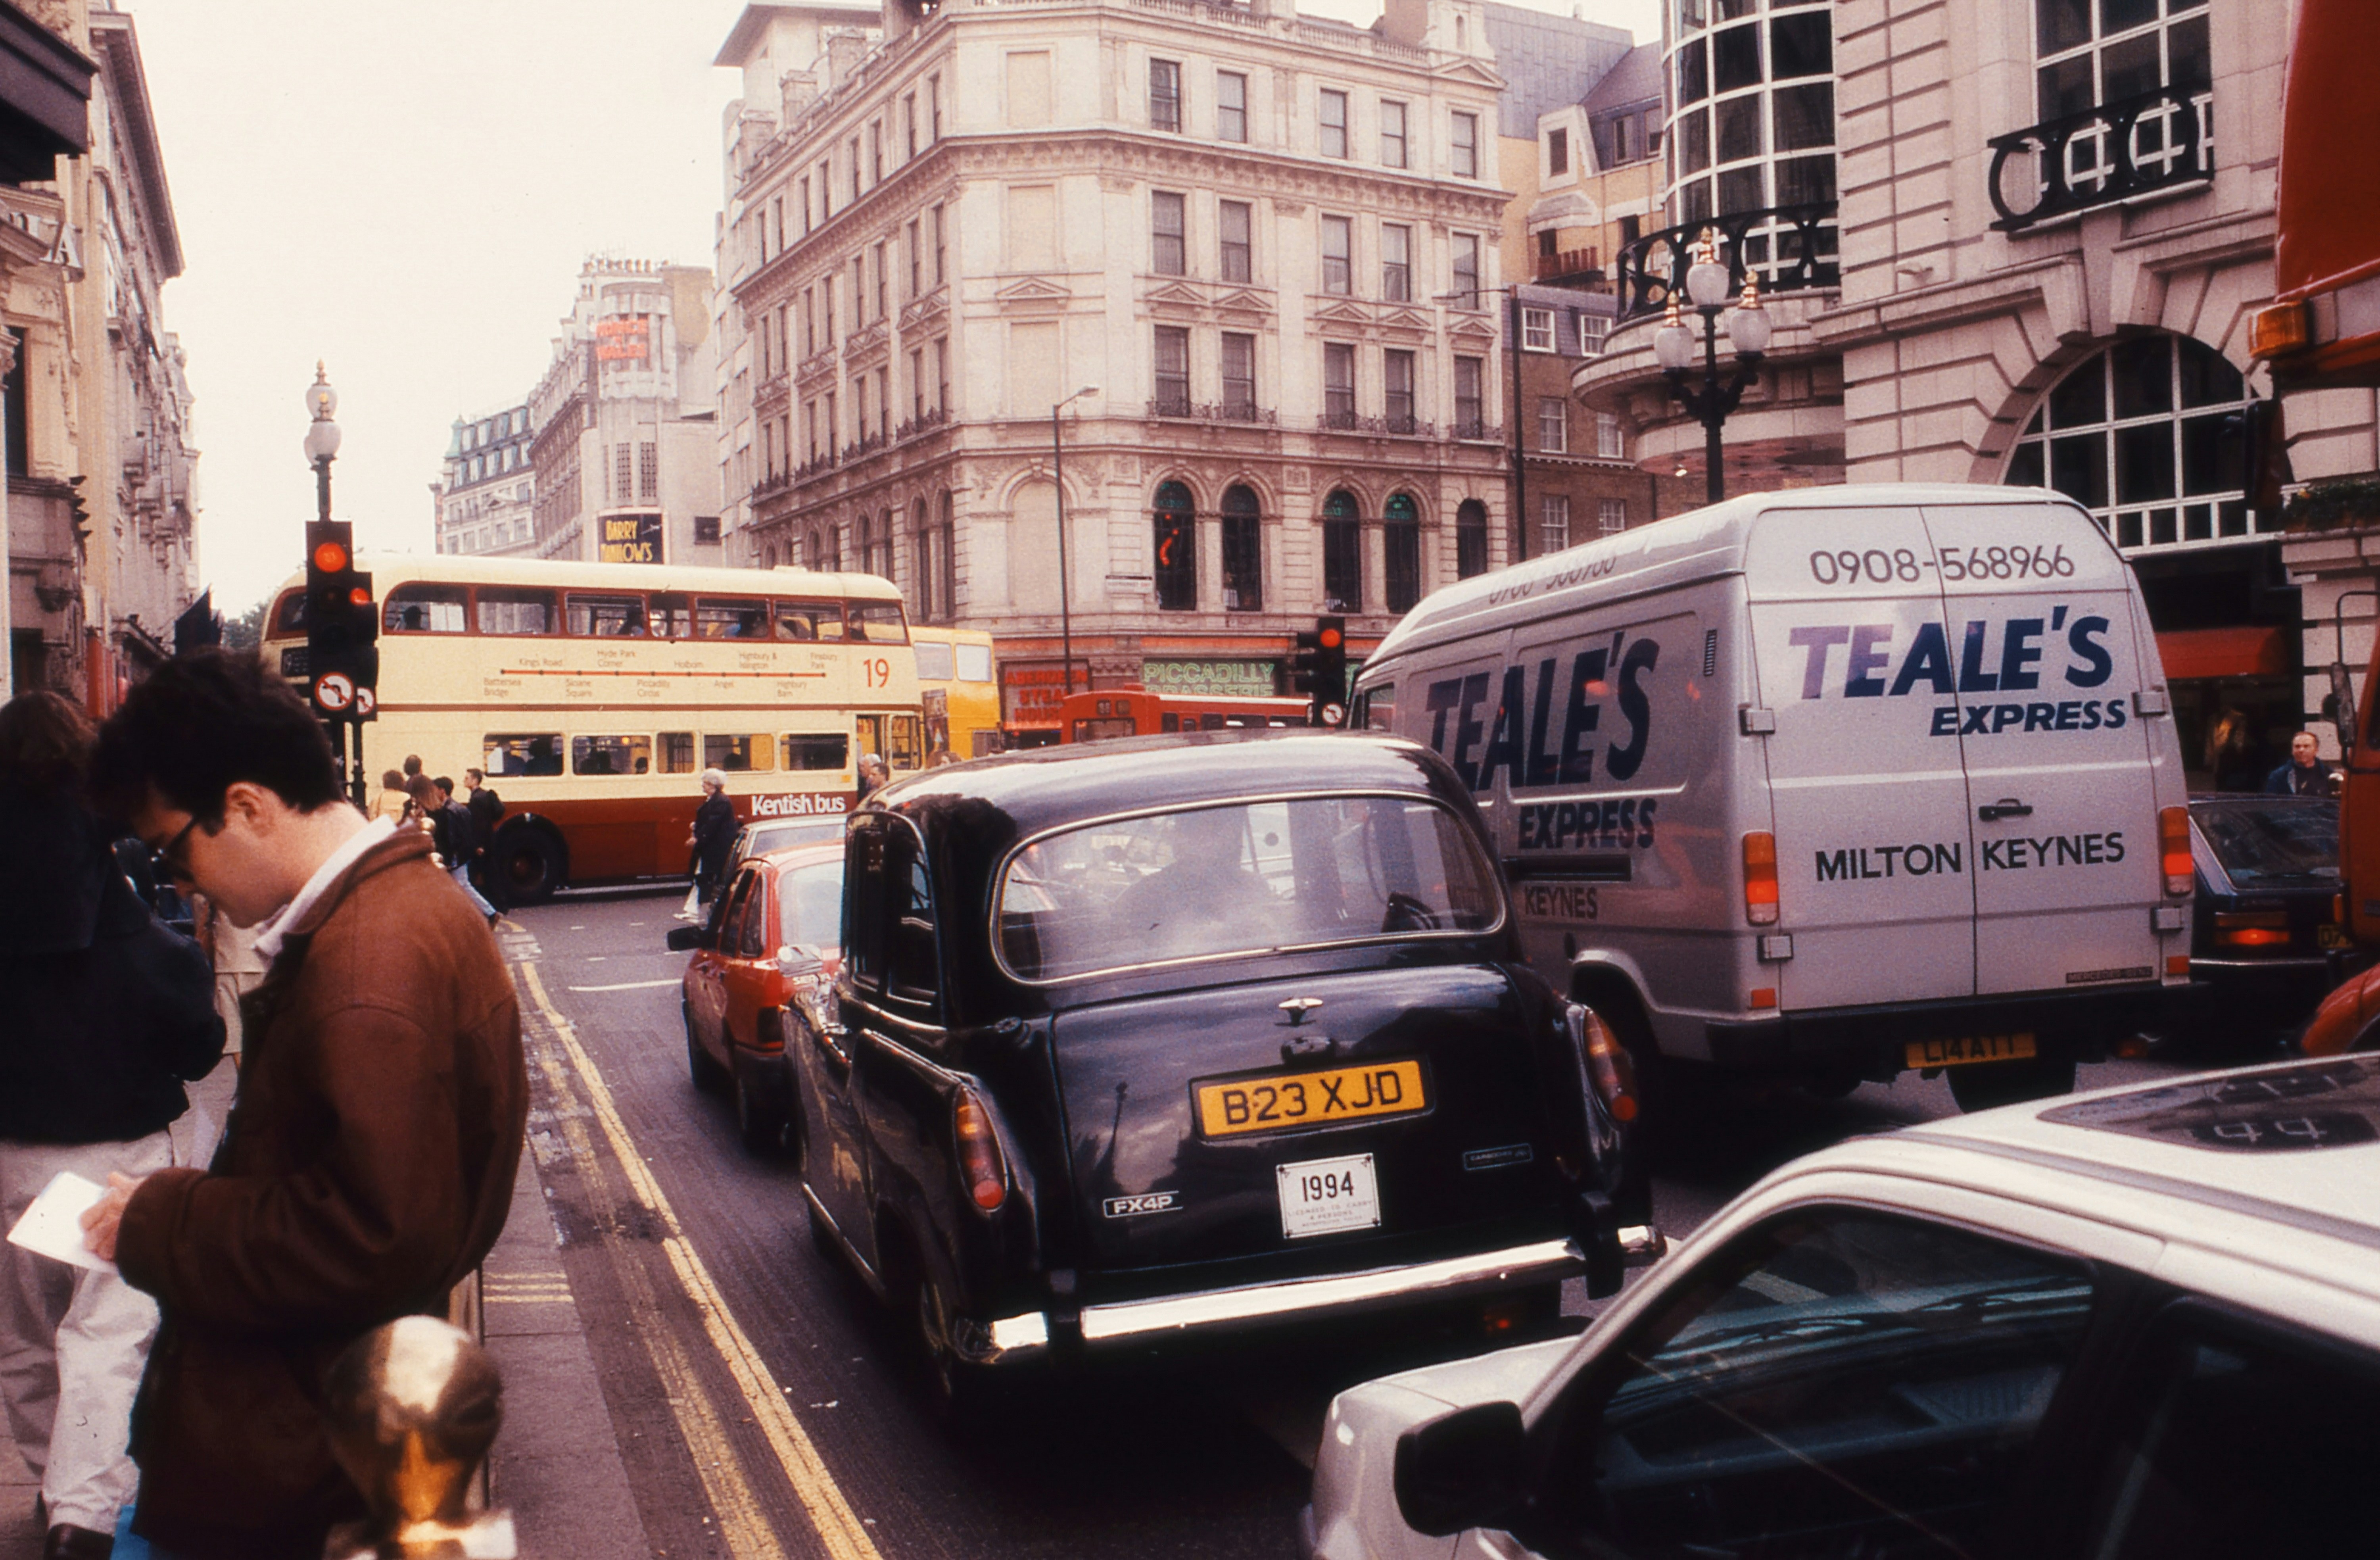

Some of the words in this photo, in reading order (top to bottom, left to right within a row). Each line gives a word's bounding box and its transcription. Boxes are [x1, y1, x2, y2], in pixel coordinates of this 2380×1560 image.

[1810, 544, 2075, 585] 0908-568966
[543, 658, 563, 666] Road
[598, 659, 623, 667] Corner
[1789, 605, 2113, 700] TEALE'S
[863, 658, 890, 688] 19
[1144, 663, 1274, 683] PICCADILLY
[1019, 688, 1068, 705] STEA
[1426, 631, 1660, 792] TEALE'S
[1929, 699, 2127, 737] EXPRESS
[751, 793, 813, 816] Kentish
[815, 793, 846, 813] bus
[1518, 798, 1656, 849] EXPRESS
[1815, 842, 1962, 882] MILTON
[1983, 832, 2125, 871] KEYNES
[1525, 886, 1598, 919] KEYNES
[1924, 1037, 1964, 1062] L14
[1223, 1082, 1307, 1125] B23
[1320, 1070, 1402, 1112] XJD
[1302, 1171, 1354, 1202] 1994
